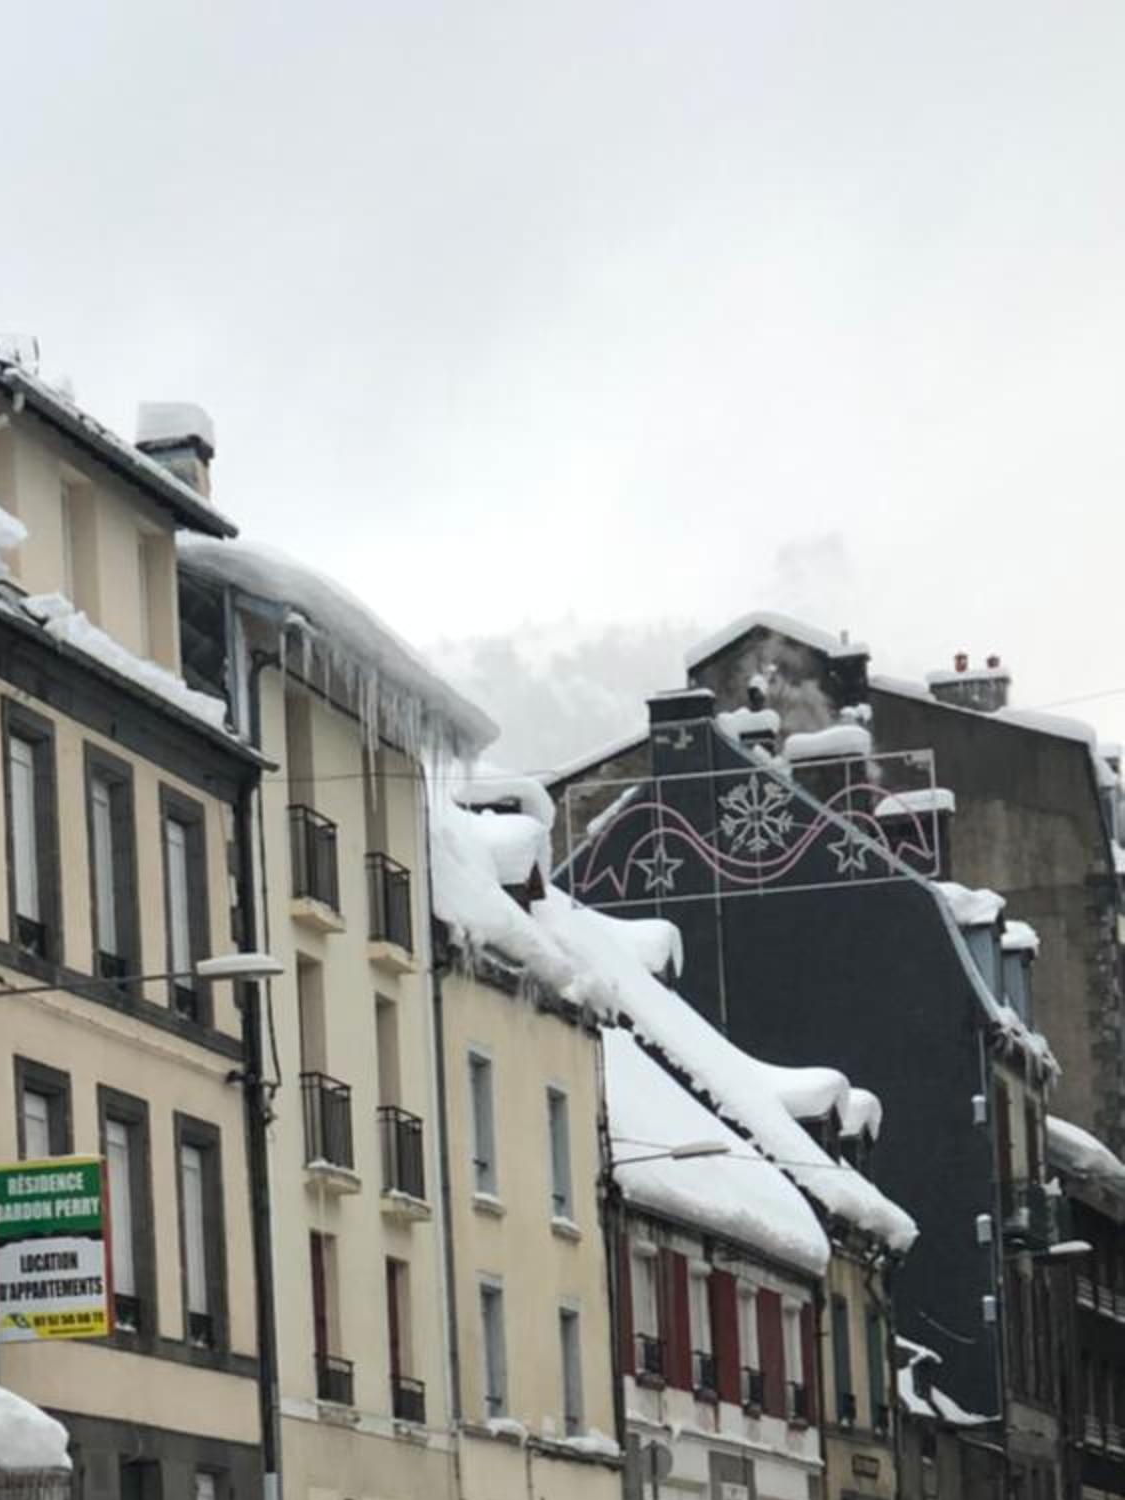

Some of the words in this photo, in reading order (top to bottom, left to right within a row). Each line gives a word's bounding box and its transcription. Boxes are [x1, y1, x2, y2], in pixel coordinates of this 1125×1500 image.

[7, 1172, 84, 1196] RÉSIDENCE
[55, 1197, 99, 1218] PERRY
[20, 1251, 78, 1274] LOCATION
